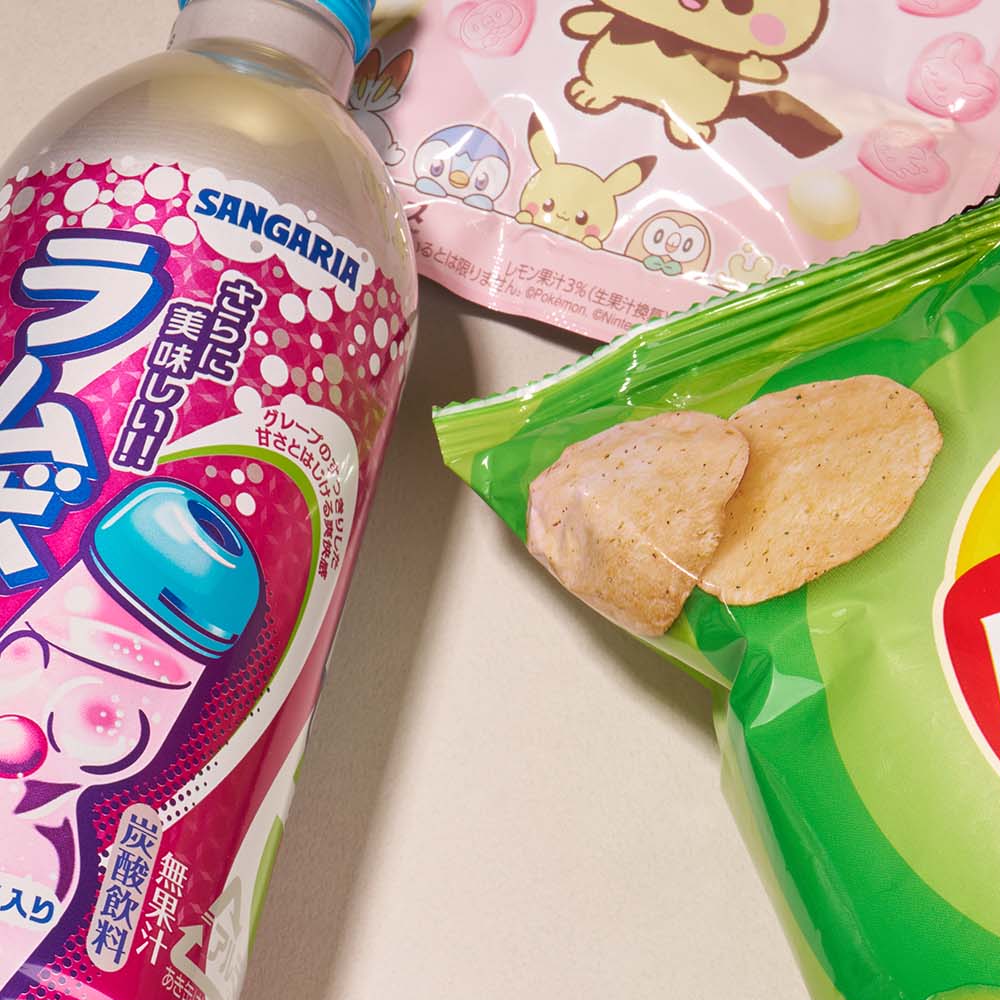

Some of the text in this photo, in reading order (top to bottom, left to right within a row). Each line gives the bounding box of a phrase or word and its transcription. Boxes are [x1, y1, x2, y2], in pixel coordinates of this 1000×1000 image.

[195, 187, 360, 292] SANGARIA
[118, 305, 208, 465] 美味しい!!
[197, 282, 257, 376] さらに
[91, 813, 158, 965] 炭酸飲料
[136, 851, 189, 965] 無果汁
